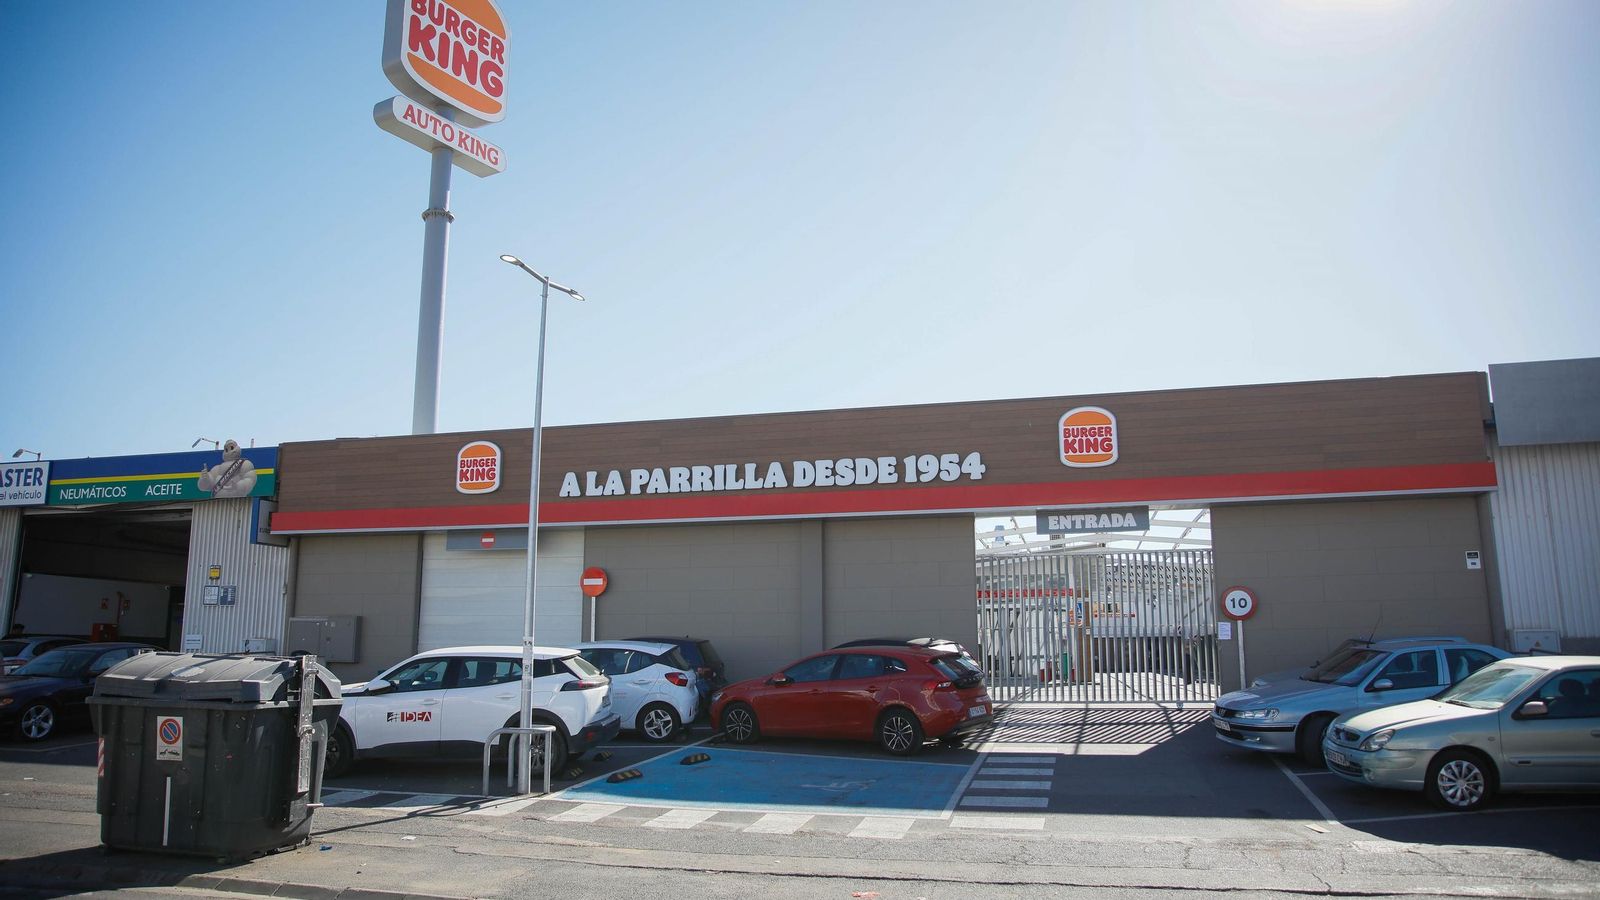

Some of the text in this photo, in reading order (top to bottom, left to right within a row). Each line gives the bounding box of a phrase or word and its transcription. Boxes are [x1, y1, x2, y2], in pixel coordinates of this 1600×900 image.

[411, 0, 505, 65] BURGER
[408, 14, 504, 98] KING
[403, 104, 500, 166] AUTO KING
[1063, 425, 1113, 439] BURGER
[1063, 437, 1114, 454] KING
[459, 457, 497, 470] BURGER
[459, 467, 496, 483] KING
[559, 451, 986, 498] A LA PARRILLA DESDE 1954
[8, 489, 42, 501] vehículo
[60, 483, 182, 500] NEUMÁTICOS ACEITE
[1047, 512, 1138, 531] ENTRADA
[1230, 597, 1248, 610] 10
[400, 711, 432, 723] IDEA
